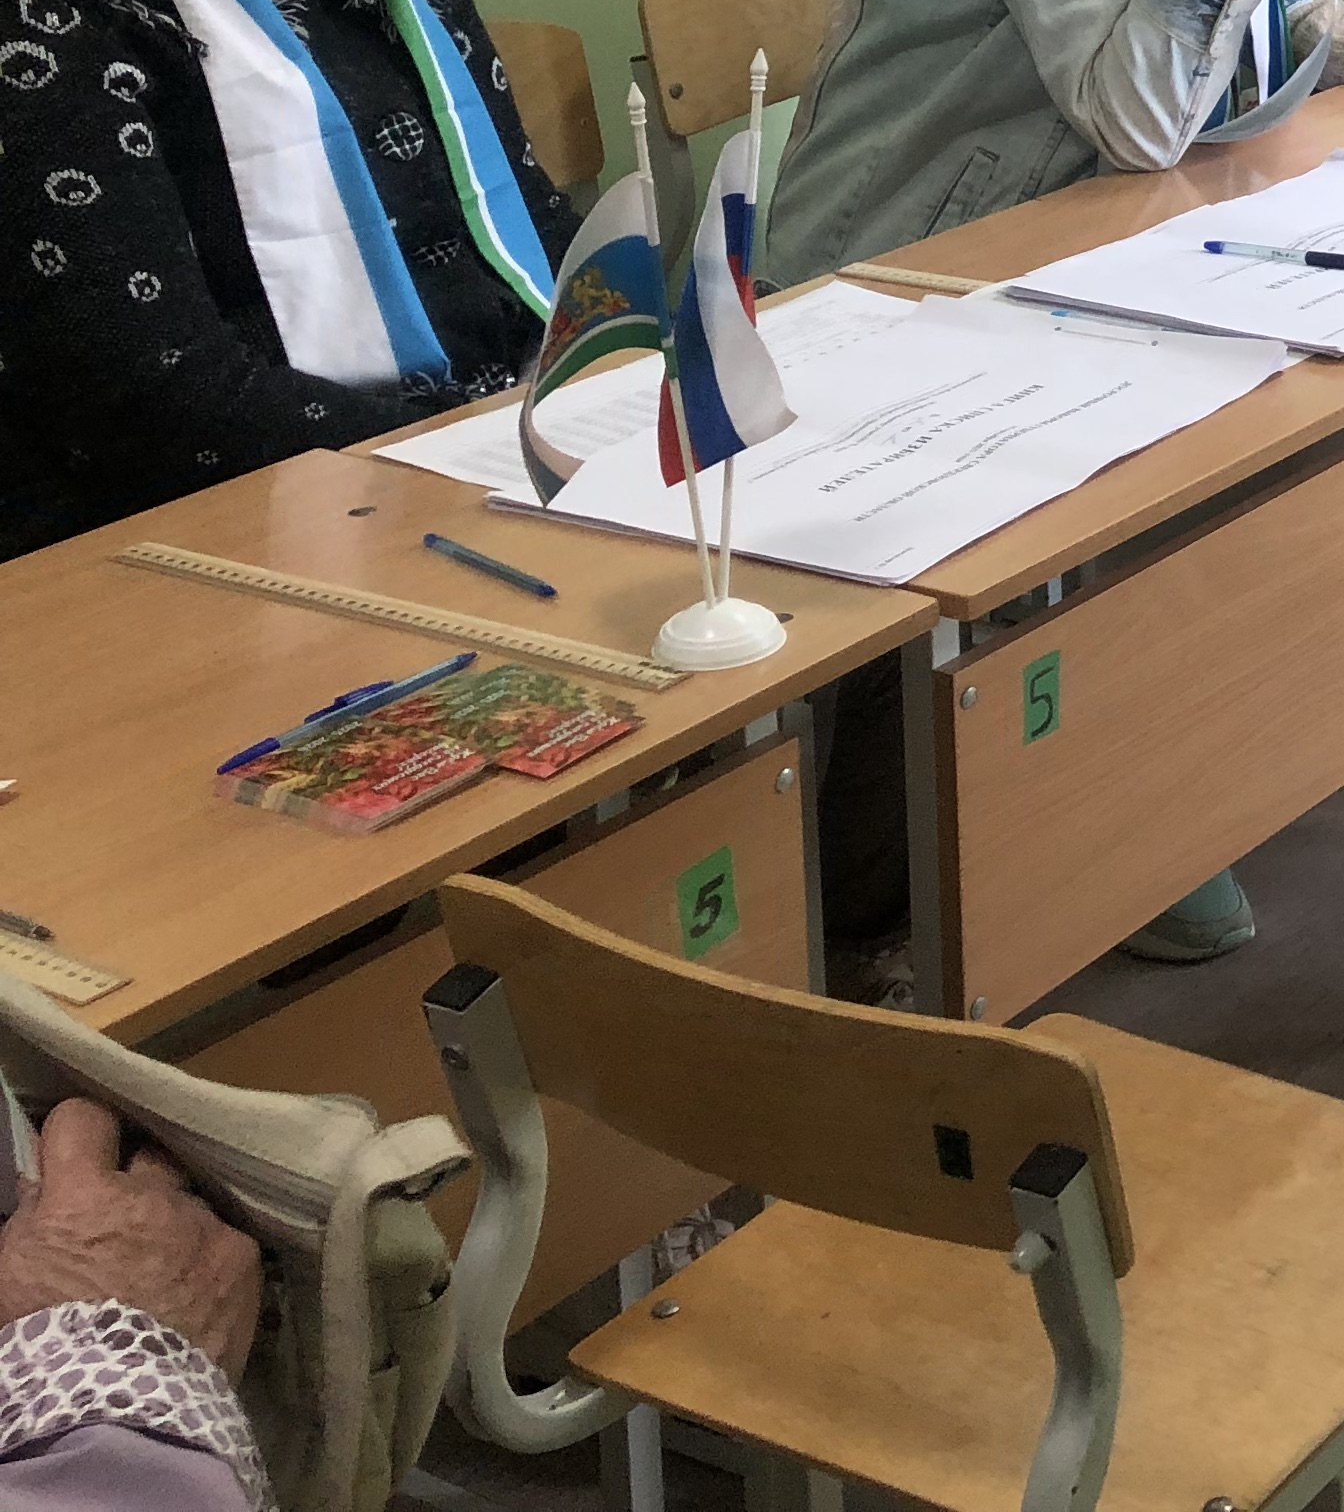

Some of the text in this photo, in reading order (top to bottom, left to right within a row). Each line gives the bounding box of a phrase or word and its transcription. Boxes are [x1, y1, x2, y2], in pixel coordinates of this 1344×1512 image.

[818, 436, 933, 492] ИЗБИРАТЕЛЕЙ
[1026, 666, 1056, 738] 5
[688, 876, 728, 940] 5
